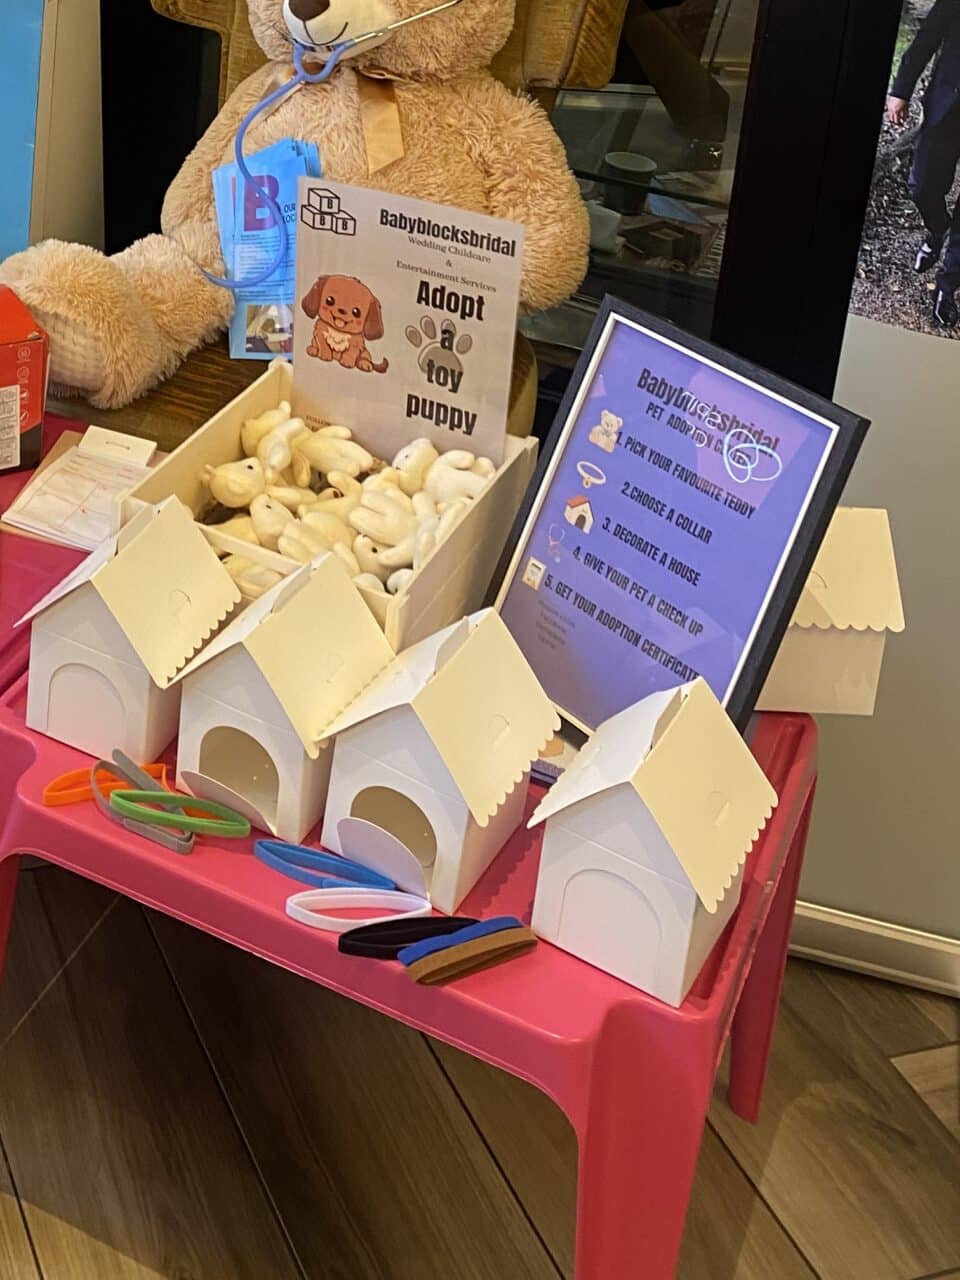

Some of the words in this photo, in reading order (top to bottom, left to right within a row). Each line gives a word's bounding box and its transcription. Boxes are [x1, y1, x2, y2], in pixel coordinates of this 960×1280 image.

[379, 208, 516, 257] Babyblocksbridal
[408, 235, 447, 253] Wedding
[447, 245, 491, 263] Childcare
[396, 260, 459, 283] Entertainment
[460, 276, 497, 293] Services
[416, 280, 485, 321] Adopt
[440, 329, 454, 352] a
[427, 358, 463, 394] toy
[406, 392, 478, 436] puppy
[646, 401, 665, 421] PET
[624, 436, 648, 458] PICK
[648, 447, 673, 473] YOUR
[672, 463, 724, 502] FAVOURITE
[724, 490, 756, 519] TEDDY
[666, 508, 676, 524] A
[675, 513, 713, 545] COLLAR
[602, 517, 611, 533] 3.
[612, 523, 661, 561] DECORATE
[658, 552, 668, 567] A
[667, 556, 702, 586] HOUSE
[544, 573, 553, 590] 5.
[555, 581, 573, 602] GET
[572, 591, 597, 617] YOUR
[595, 609, 642, 648] ADOPTION
[572, 545, 581, 561] 4.
[583, 552, 606, 574] GIVE
[604, 564, 630, 591] YOUR
[628, 581, 649, 603] PET
[647, 593, 657, 609] A
[656, 599, 690, 629] CHECK
[688, 619, 704, 637] UP
